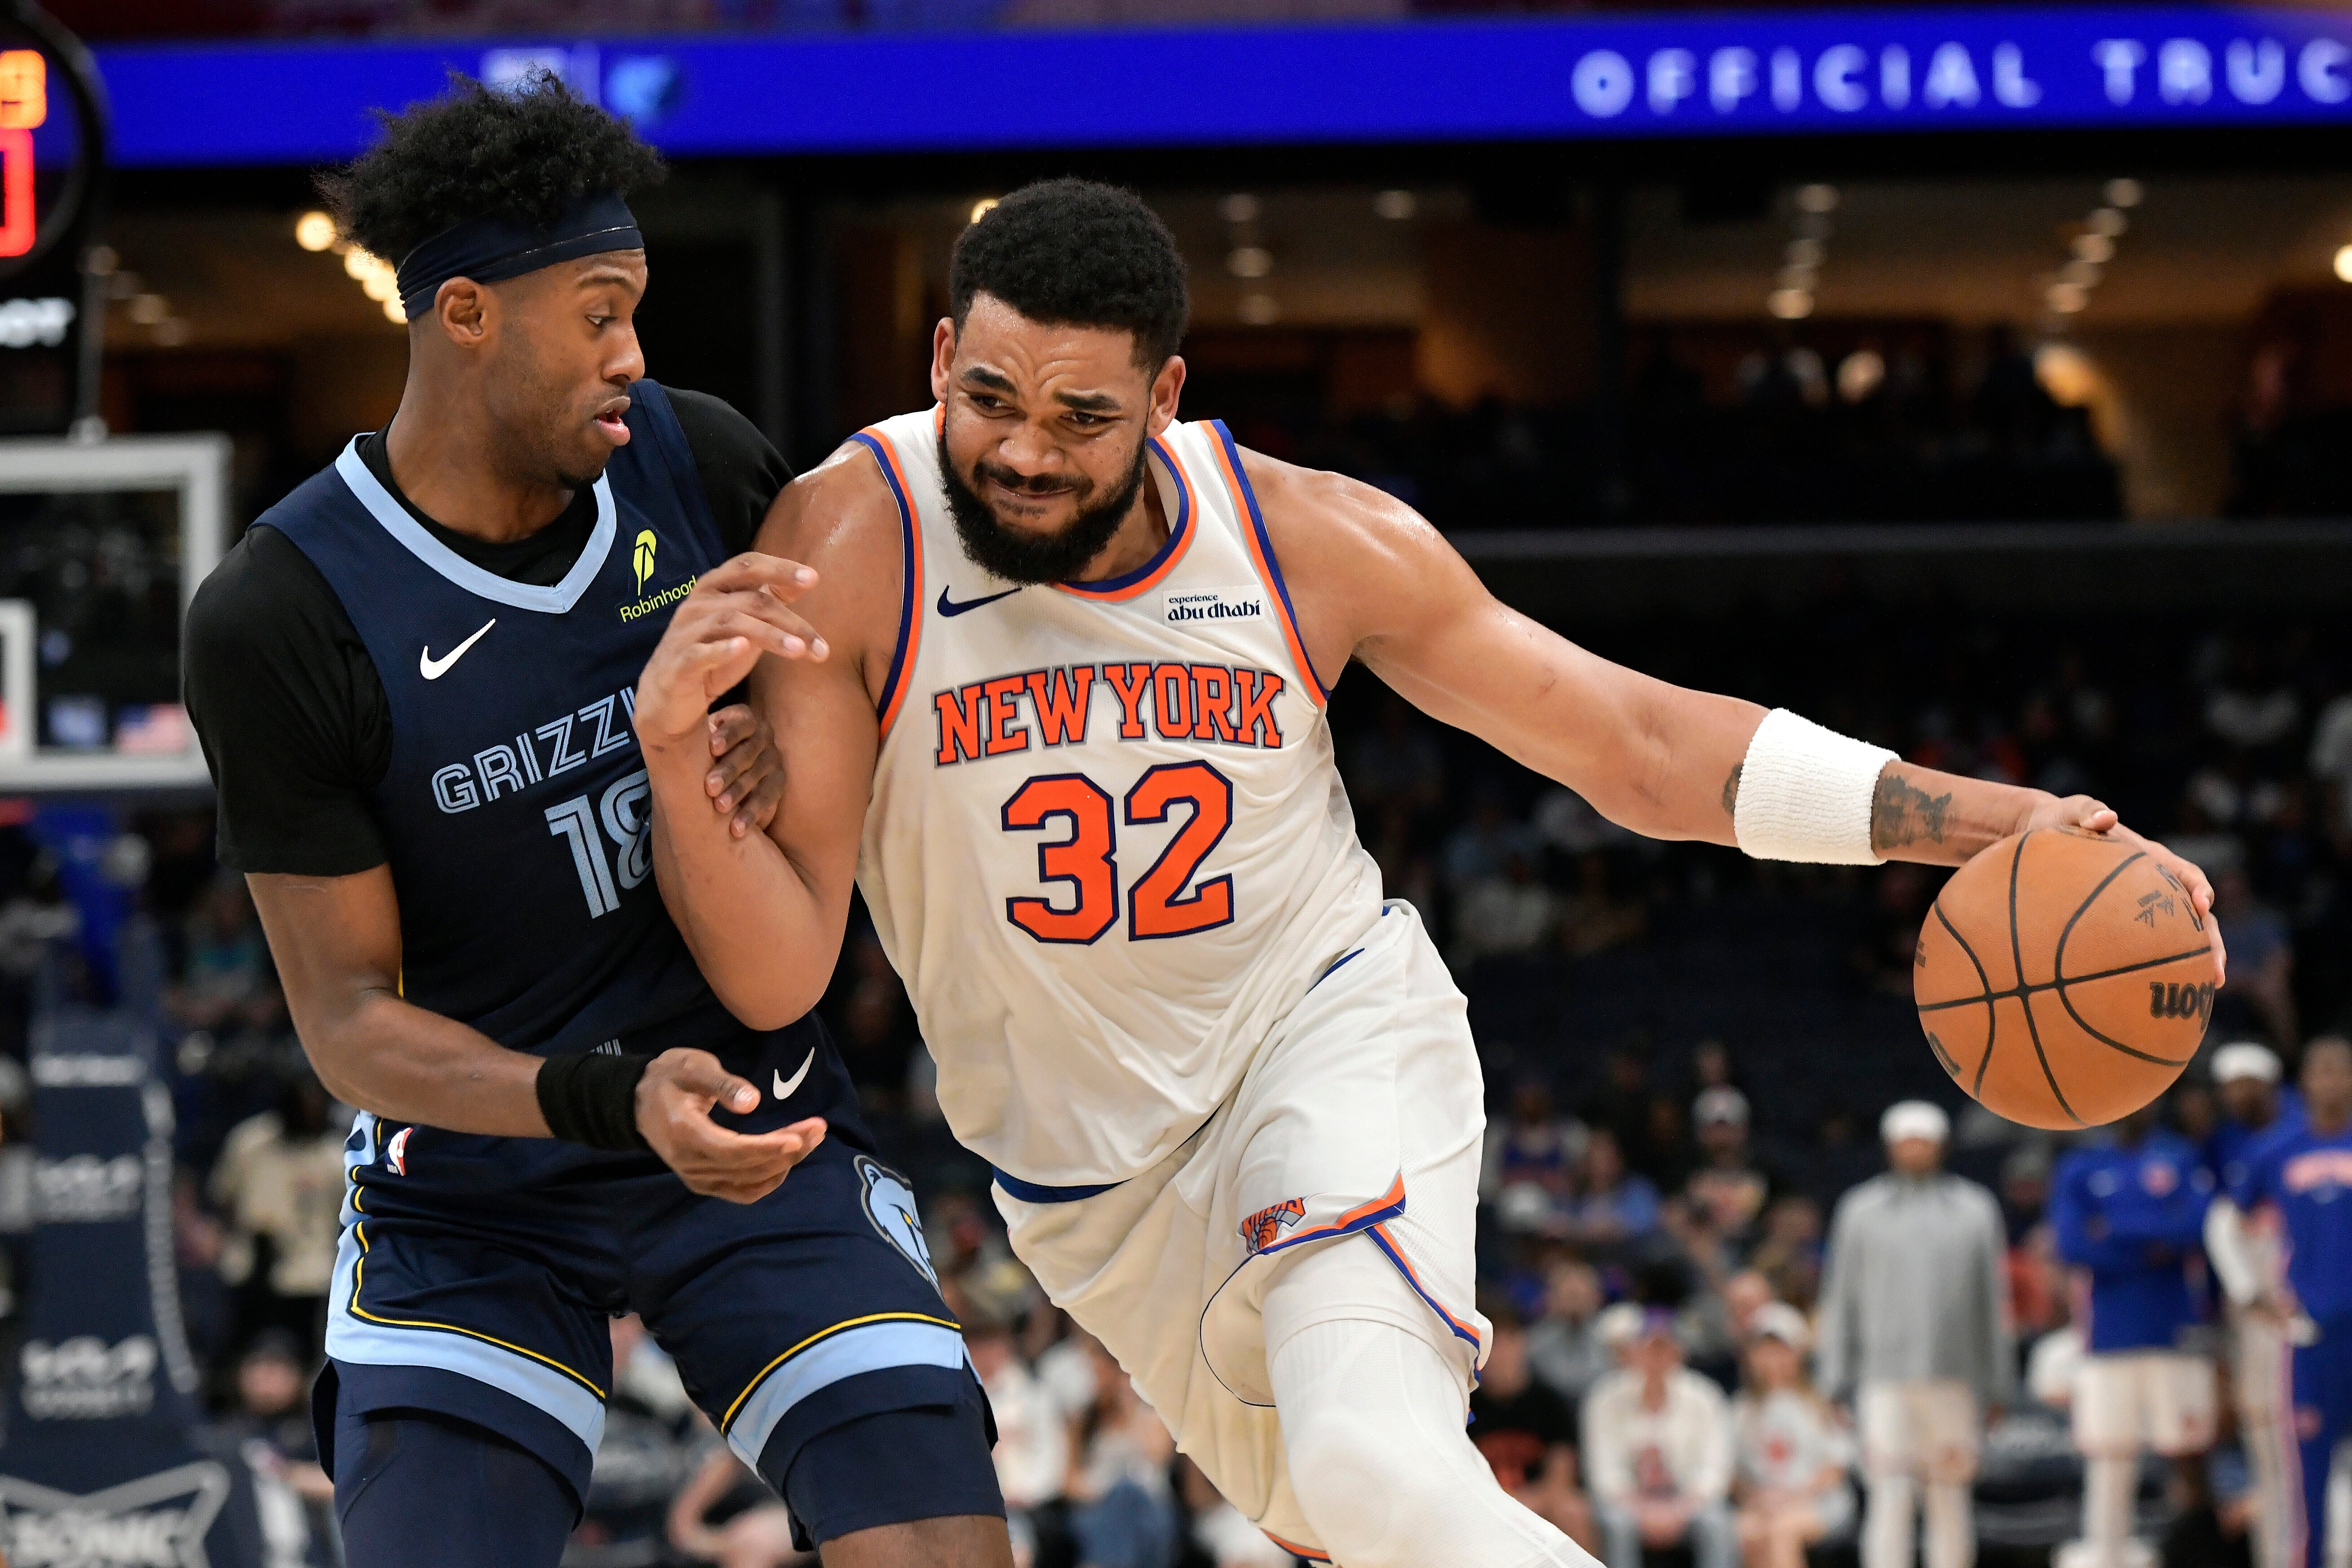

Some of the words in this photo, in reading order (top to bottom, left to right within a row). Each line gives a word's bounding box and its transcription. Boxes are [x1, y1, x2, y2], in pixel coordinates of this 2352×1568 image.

[1570, 40, 2043, 119] OFFICIAL
[620, 575, 697, 623] Robinhood
[1168, 605, 1204, 621] abu
[1207, 600, 1261, 618] dhabi
[1169, 594, 1218, 604] experience
[932, 663, 1098, 768] NEW
[1102, 660, 1286, 749] YORK
[544, 768, 654, 919] 18
[1001, 760, 1234, 945] 32
